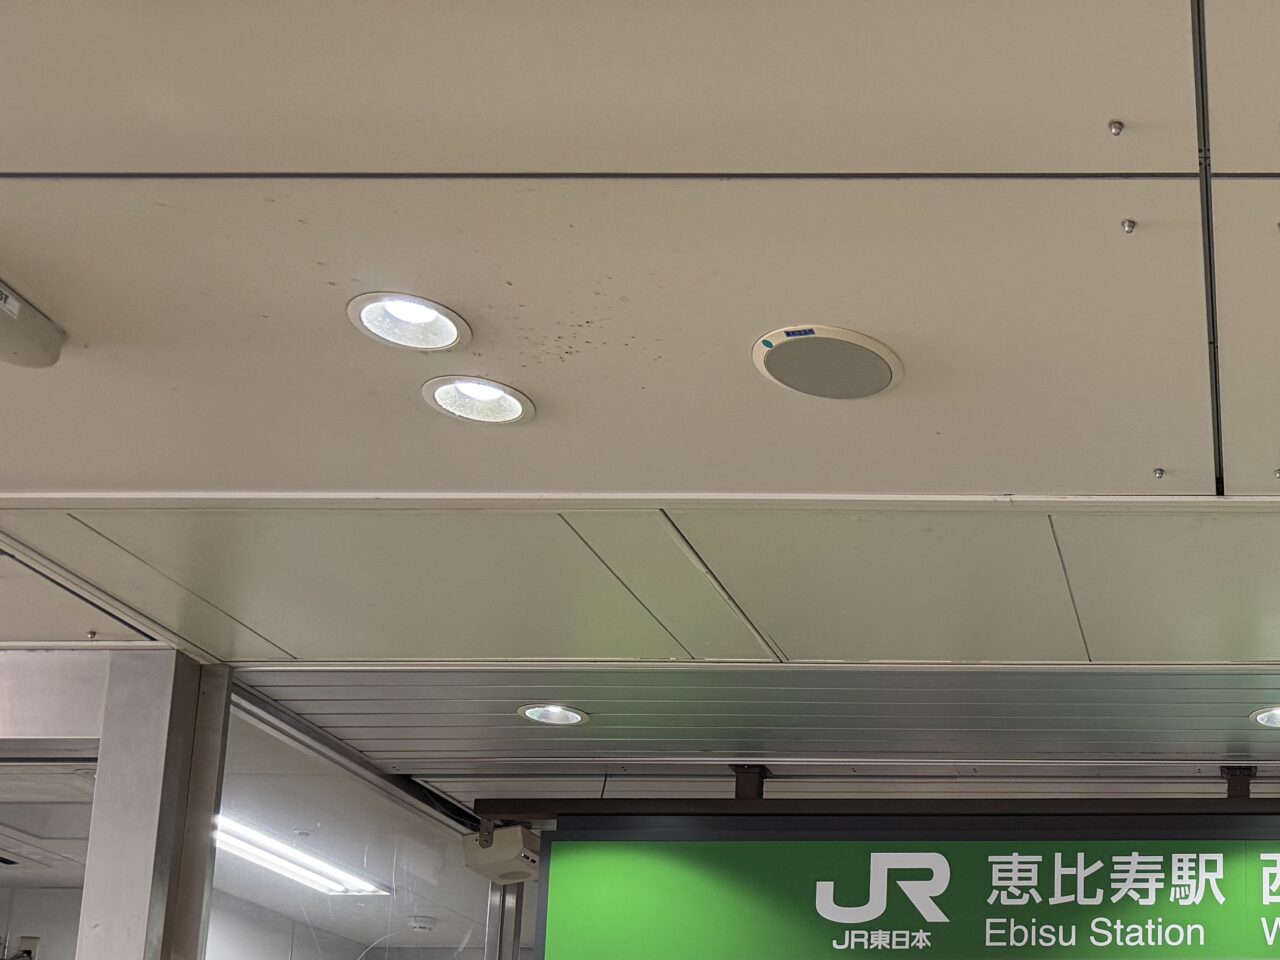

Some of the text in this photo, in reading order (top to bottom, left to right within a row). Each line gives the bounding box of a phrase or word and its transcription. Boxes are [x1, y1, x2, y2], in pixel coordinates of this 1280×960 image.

[816, 852, 951, 924] JR
[986, 852, 1225, 906] 恵比寿駅
[832, 930, 932, 950] JR東日本
[985, 917, 1077, 948] Ebisu
[1089, 917, 1206, 948] Station
